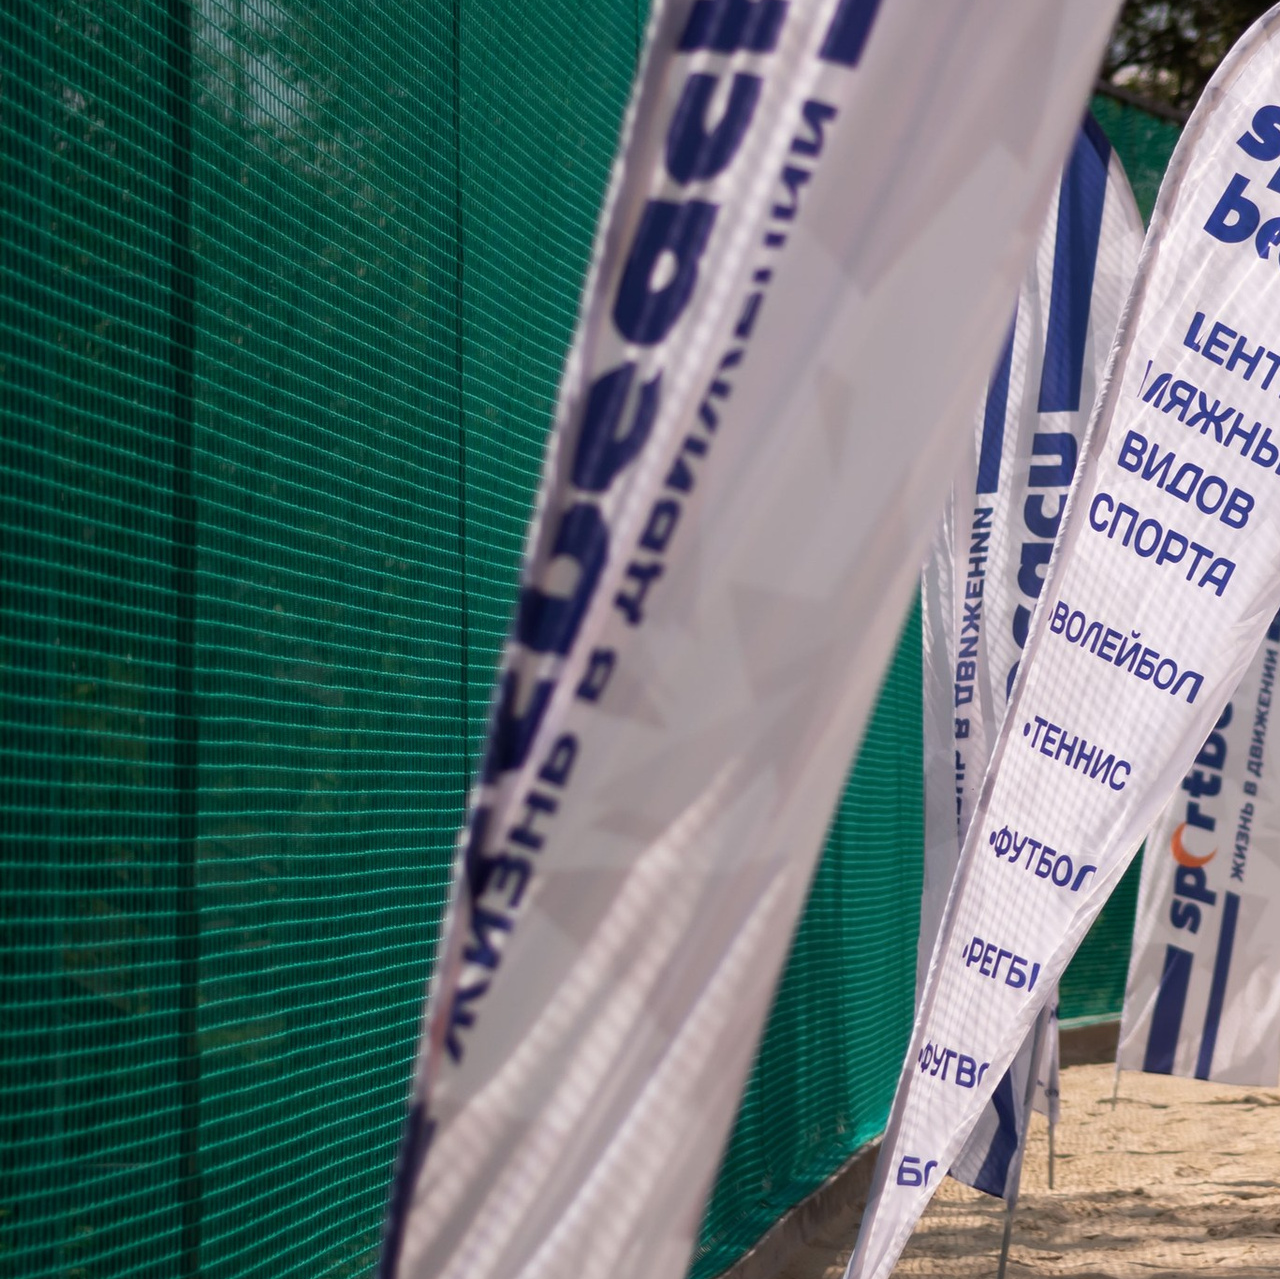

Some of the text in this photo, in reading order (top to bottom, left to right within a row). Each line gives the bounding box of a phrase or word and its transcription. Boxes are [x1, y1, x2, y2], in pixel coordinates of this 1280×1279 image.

[1117, 430, 1255, 529] ВИДОВ
[1089, 492, 1237, 597] СПОРТА
[1230, 647, 1279, 884] ЖИЗНЬ В ДВИЖЕНИИ
